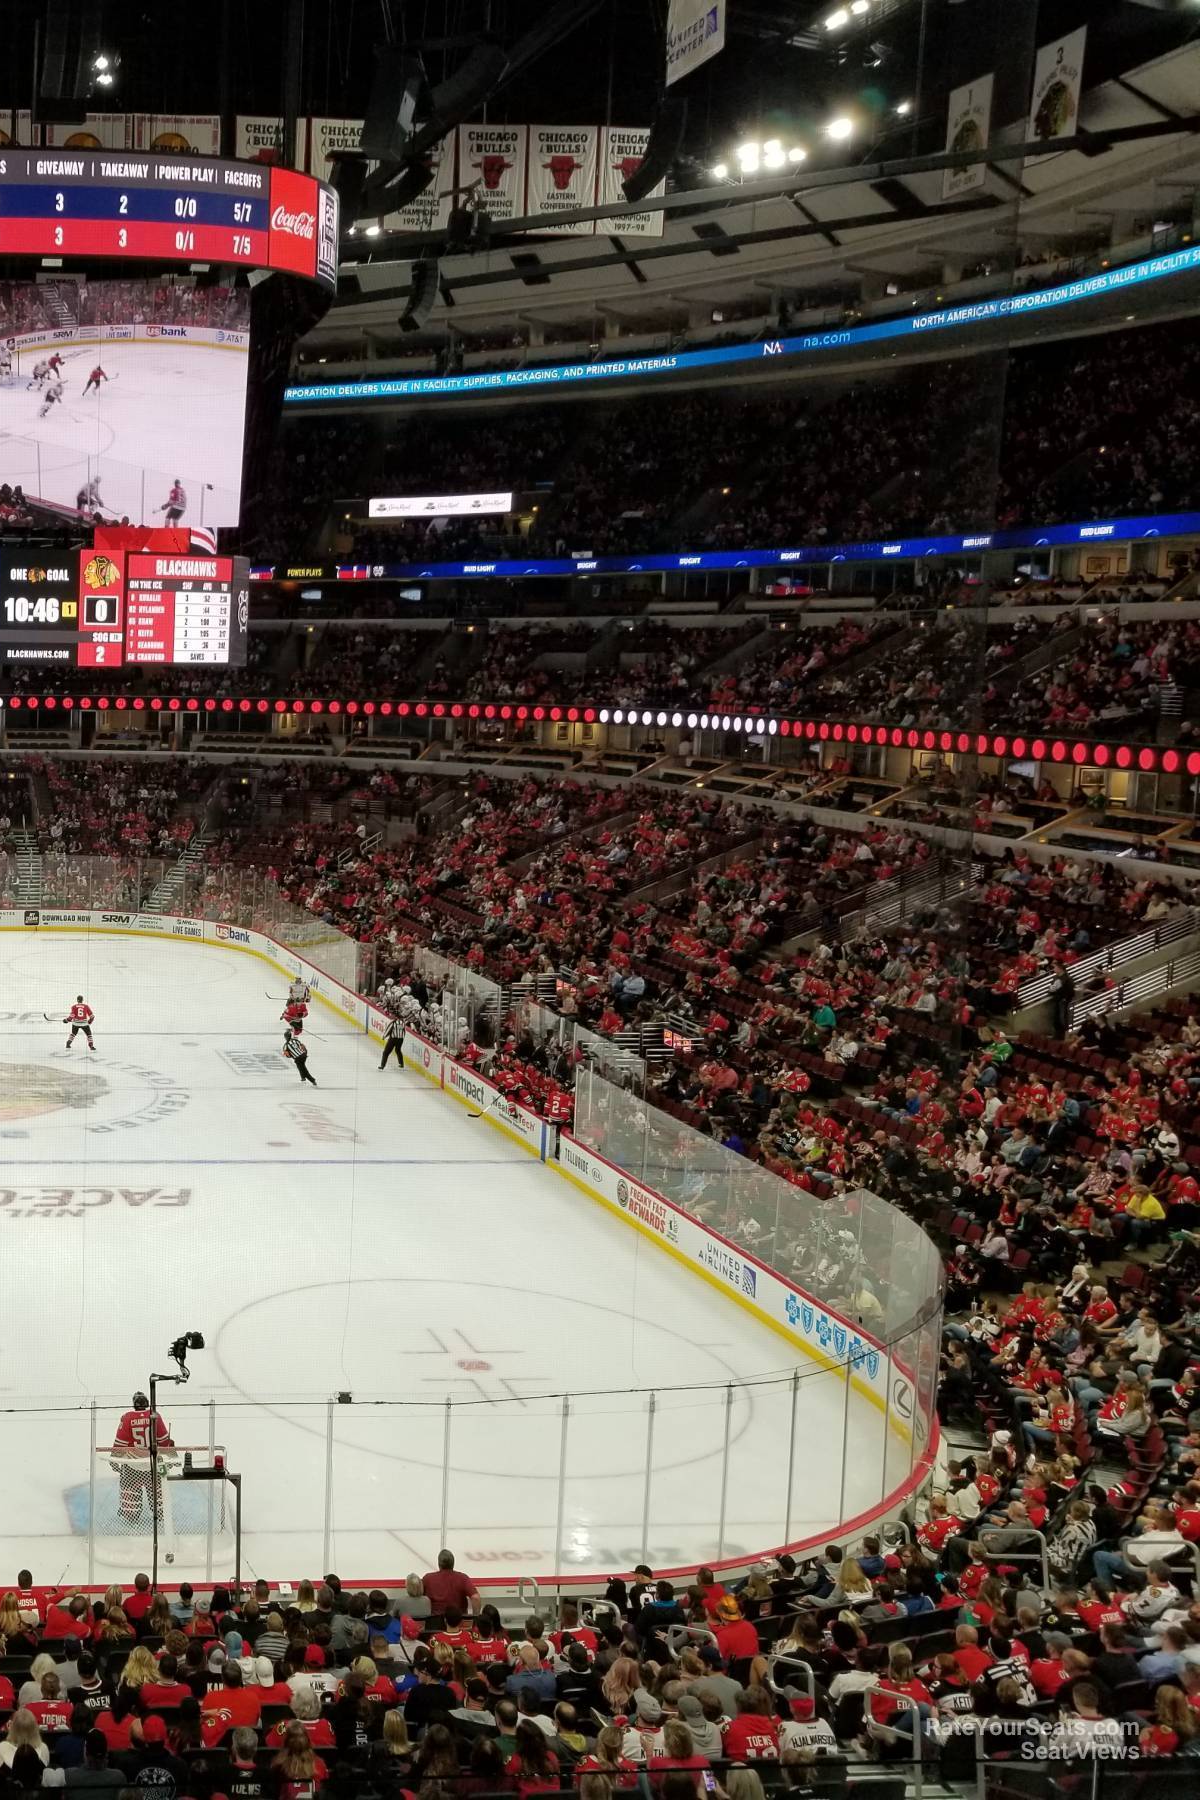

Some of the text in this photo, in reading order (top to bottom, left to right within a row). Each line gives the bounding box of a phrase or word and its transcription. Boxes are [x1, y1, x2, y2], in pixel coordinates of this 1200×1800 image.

[670, 17, 705, 48] UNITED
[468, 131, 519, 142] CHICAGO
[537, 132, 589, 143] CHICAGO
[476, 142, 512, 153] BULLS
[546, 143, 581, 154] BULLS
[36, 161, 84, 176] GIVEAWAY
[100, 162, 149, 179] TAKEAWAY
[159, 166, 191, 181] POWER
[192, 167, 215, 182] PLAY
[224, 170, 262, 189] FACEOFFS
[546, 192, 576, 201] EASTERN
[55, 193, 64, 212] 3
[119, 195, 128, 214] 2
[175, 197, 197, 218] 0/0
[233, 203, 252, 223] 5/7
[539, 201, 583, 211] CONFERENCE
[271, 205, 316, 240] Coca-Cola
[614, 222, 646, 232] 1997-98
[55, 226, 63, 246] 3
[119, 228, 127, 248] 3
[175, 231, 194, 252] 0/1
[233, 236, 251, 256] 7/5
[912, 252, 1190, 329] NORTH AMERICAN CORPORATION DELIVERS VALUE IN FACILITY
[160, 326, 187, 337] bank
[226, 334, 243, 344] AT&T
[803, 330, 851, 347] na.com
[338, 357, 677, 397] DELIVERS VALUE IN FACILITY SUPPLIES, PACKAGING, AND PRINTED MATERIALS
[155, 559, 217, 577] BLACKHAWKS
[287, 567, 322, 577] POWER PLAYS
[10, 568, 69, 581] ONE GOAL
[4, 597, 60, 623] 10:46
[95, 599, 108, 622] 0
[92, 632, 109, 642] SOG
[7, 650, 69, 659] BLACKHAWKS.COM
[95, 645, 105, 663] 2
[42, 914, 76, 922] DOWNLOAD
[101, 914, 130, 924] SRM
[172, 926, 202, 937] LIVE GAMES
[229, 931, 250, 944] bank
[456, 1068, 485, 1104] impact
[565, 1147, 589, 1175] TELLURIDE
[630, 1186, 667, 1217] FREAKY FAST
[4, 1208, 87, 1218] NHL
[628, 1199, 666, 1234] REWARDS
[707, 1242, 740, 1272] UNITED
[698, 1250, 740, 1285] AIRLINES
[480, 1653, 497, 1662] KANE
[310, 1681, 326, 1691] KANE
[41, 1713, 66, 1725] TOEWS
[746, 1736, 773, 1747] TOEWS
